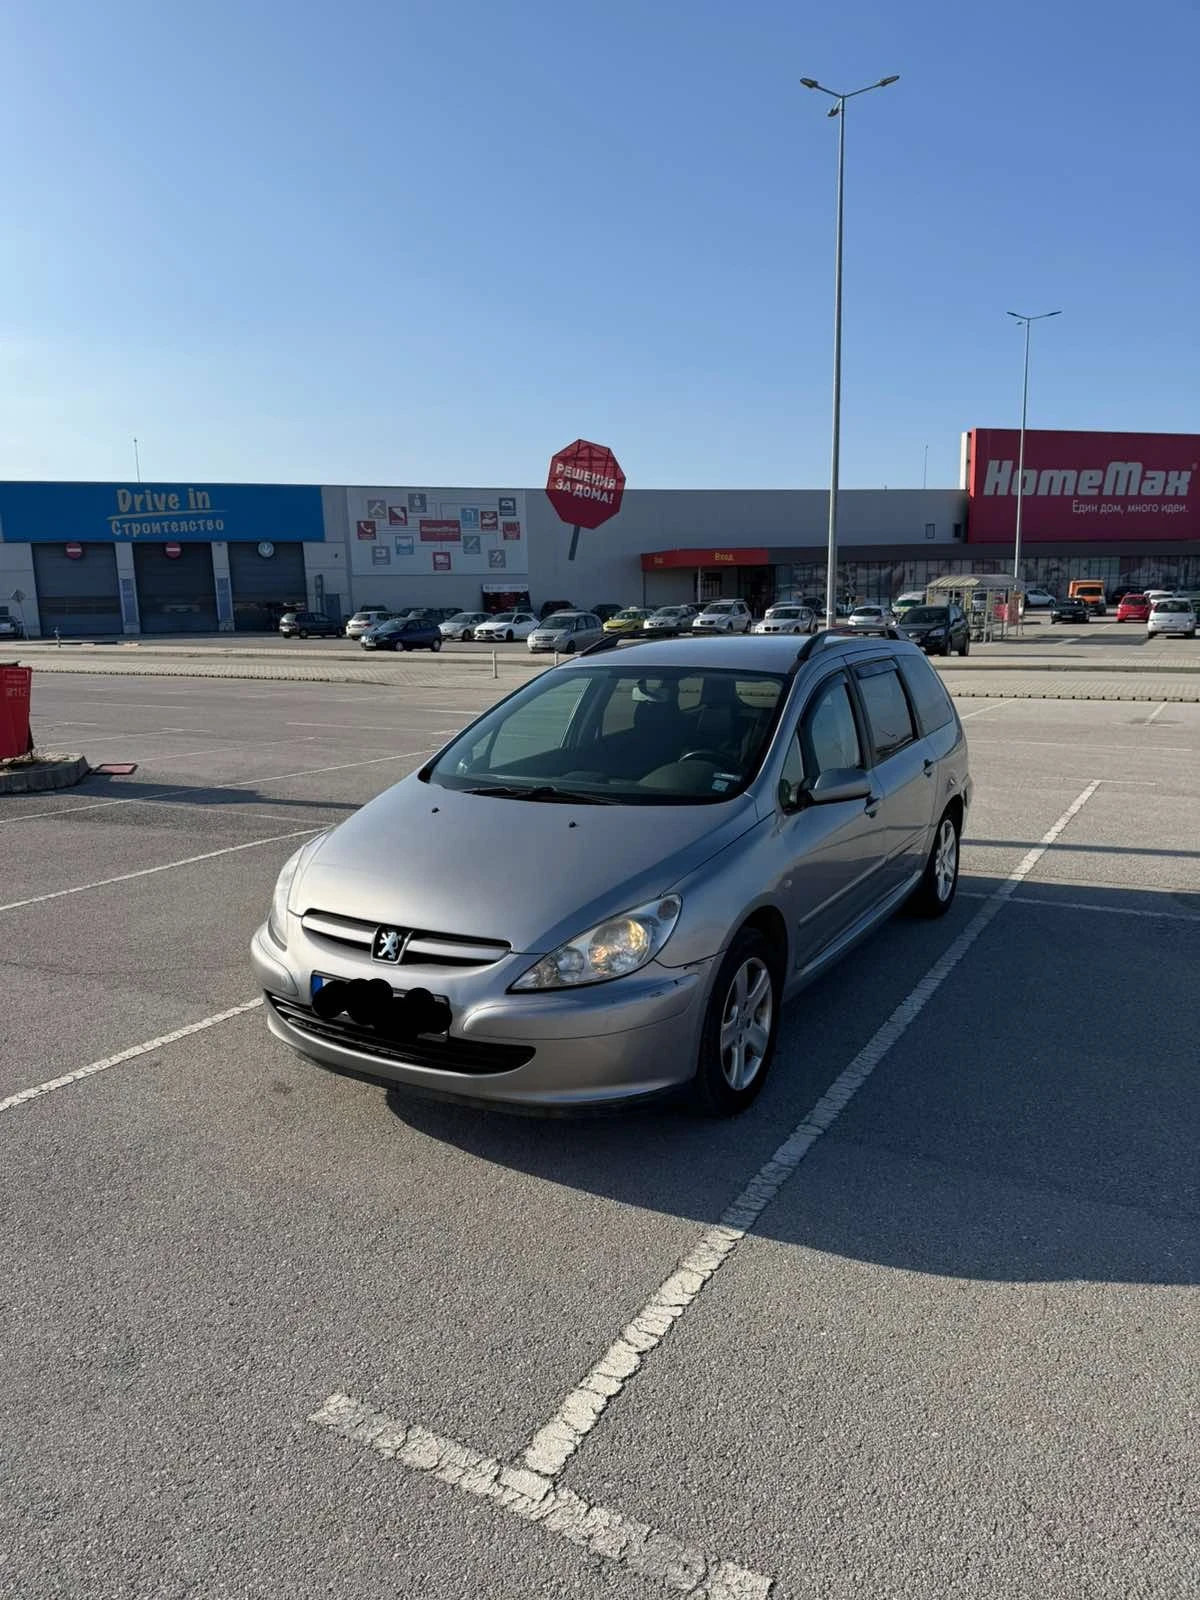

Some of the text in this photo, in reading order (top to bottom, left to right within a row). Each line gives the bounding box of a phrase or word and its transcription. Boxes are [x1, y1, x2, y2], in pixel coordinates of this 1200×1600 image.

[555, 463, 617, 489] РЕШЕНИЯ
[983, 459, 1192, 497] HomeMax
[117, 487, 210, 513] Drive in
[555, 478, 614, 505] ЗА ДОМА!
[1072, 499, 1098, 514] Един
[1127, 503, 1159, 513] много
[1160, 503, 1189, 514] идеи.
[111, 519, 225, 537] Строителство
